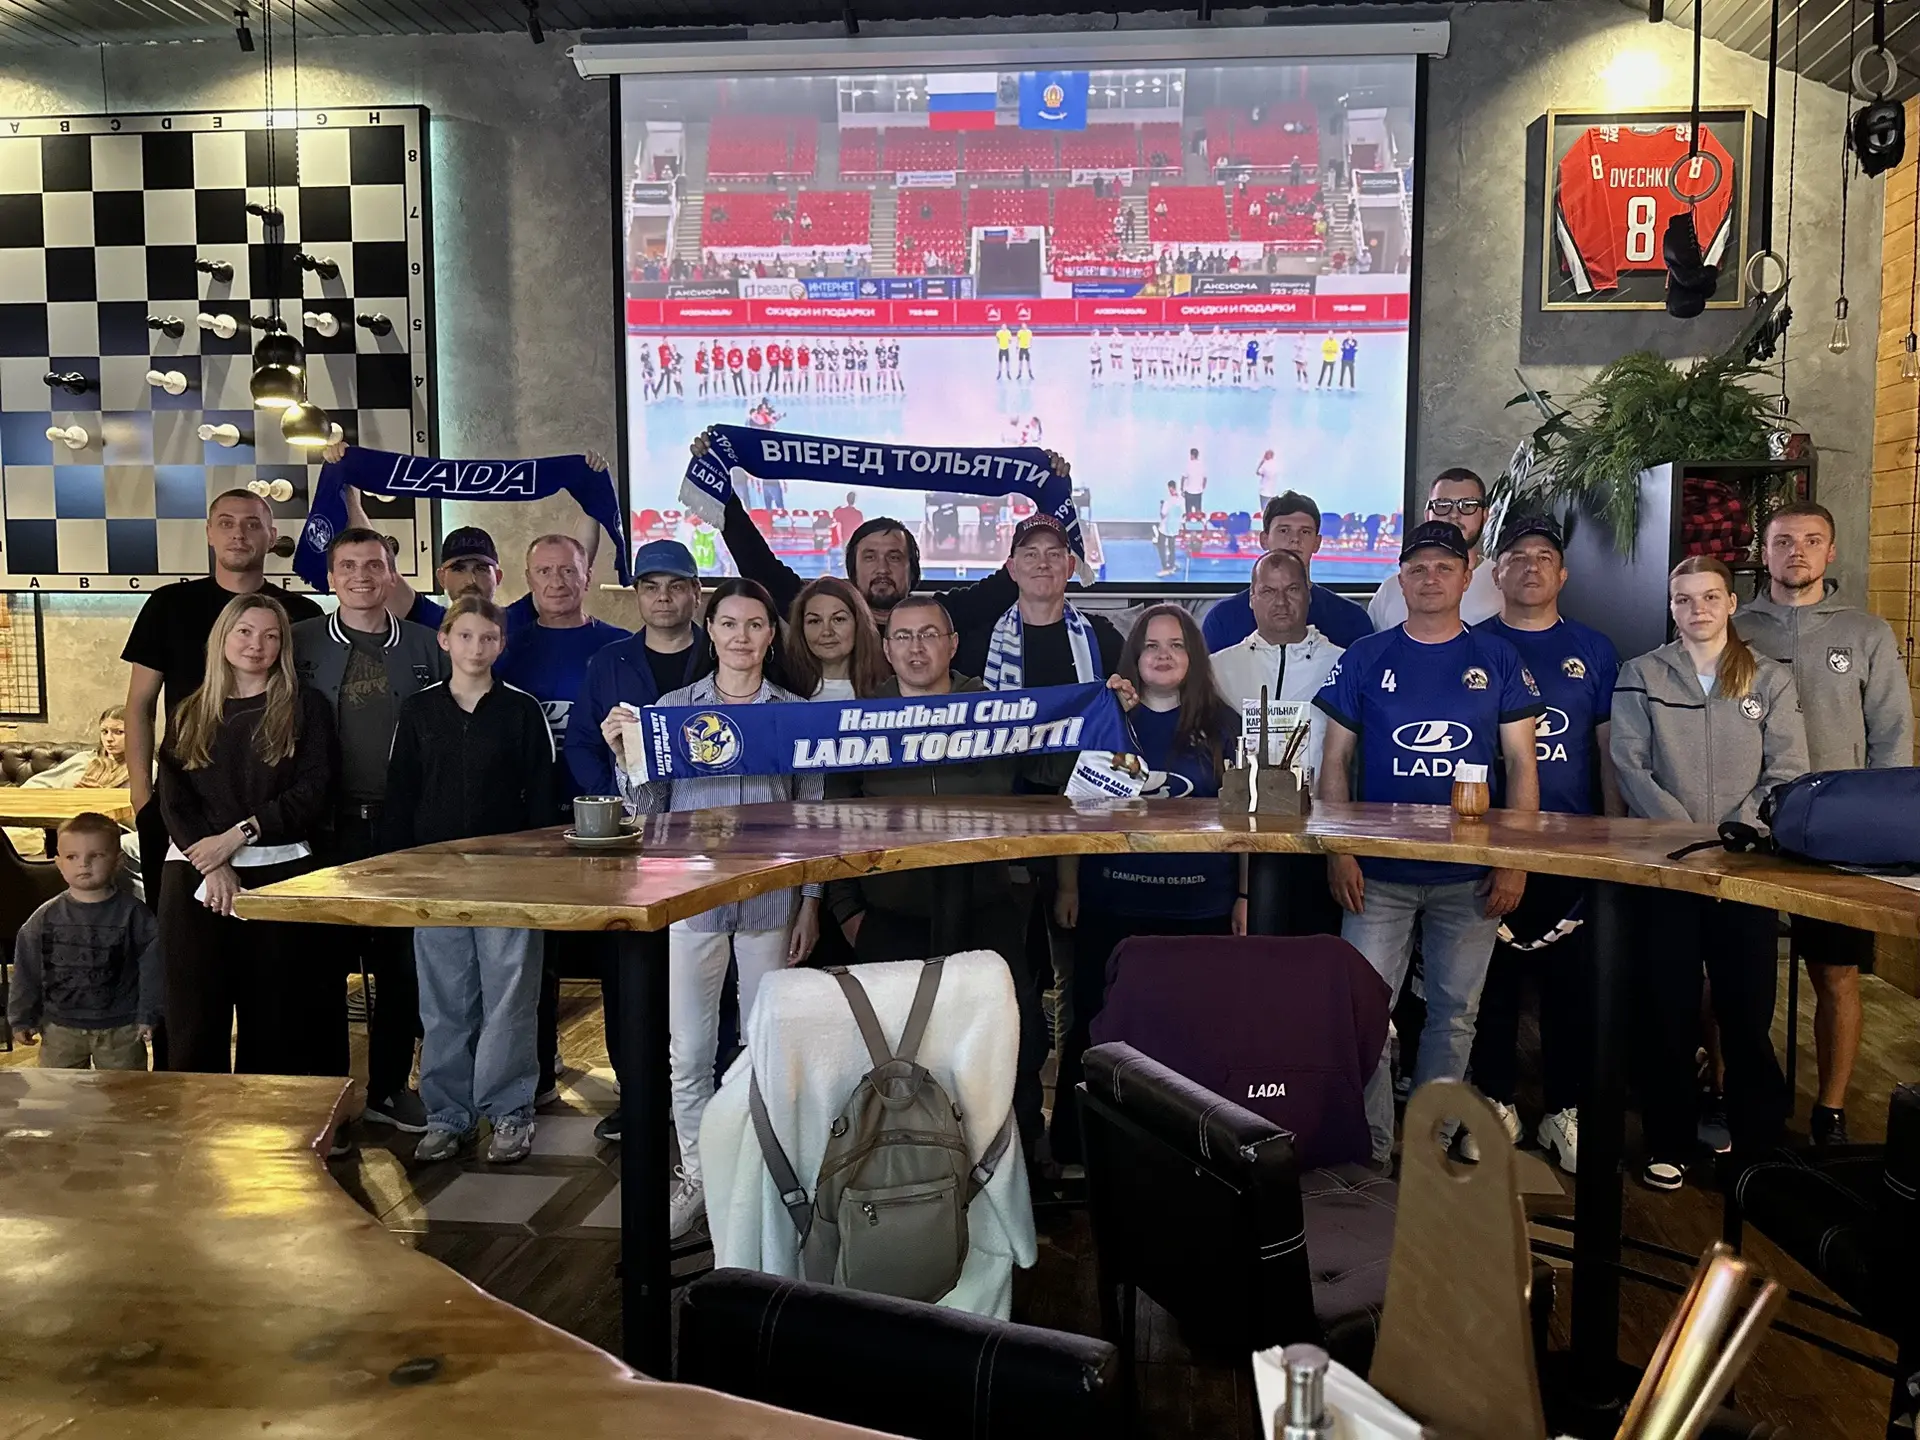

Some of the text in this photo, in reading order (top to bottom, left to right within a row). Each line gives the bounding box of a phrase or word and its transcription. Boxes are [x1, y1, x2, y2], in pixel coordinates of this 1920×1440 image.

[1590, 154, 1604, 180] 8
[1688, 156, 1703, 179] 8
[1625, 196, 1657, 262] 8
[1203, 282, 1258, 291] АКСИОМА
[765, 307, 812, 317] СКИДКИ
[822, 307, 876, 317] ПОДАРКИ
[1181, 304, 1228, 315] СКИДКИ
[1239, 303, 1296, 314] ПОДАРКИ
[386, 454, 537, 495] LADA
[761, 439, 1051, 489] ВПЕРЕД ТОЛЬЯТТИ
[691, 463, 725, 494] LADA
[29, 577, 40, 588] A
[79, 577, 90, 588] B
[129, 577, 140, 589] C
[1380, 668, 1397, 693] 4
[839, 697, 1039, 732] Handball Club
[650, 711, 666, 776] LADA TOGLIATTI
[792, 716, 1085, 769] LADA TOGLIATTI
[1112, 870, 1206, 886] САМАРСКАЯ ОБЛАСТЬ
[1247, 1082, 1286, 1099] LADA
